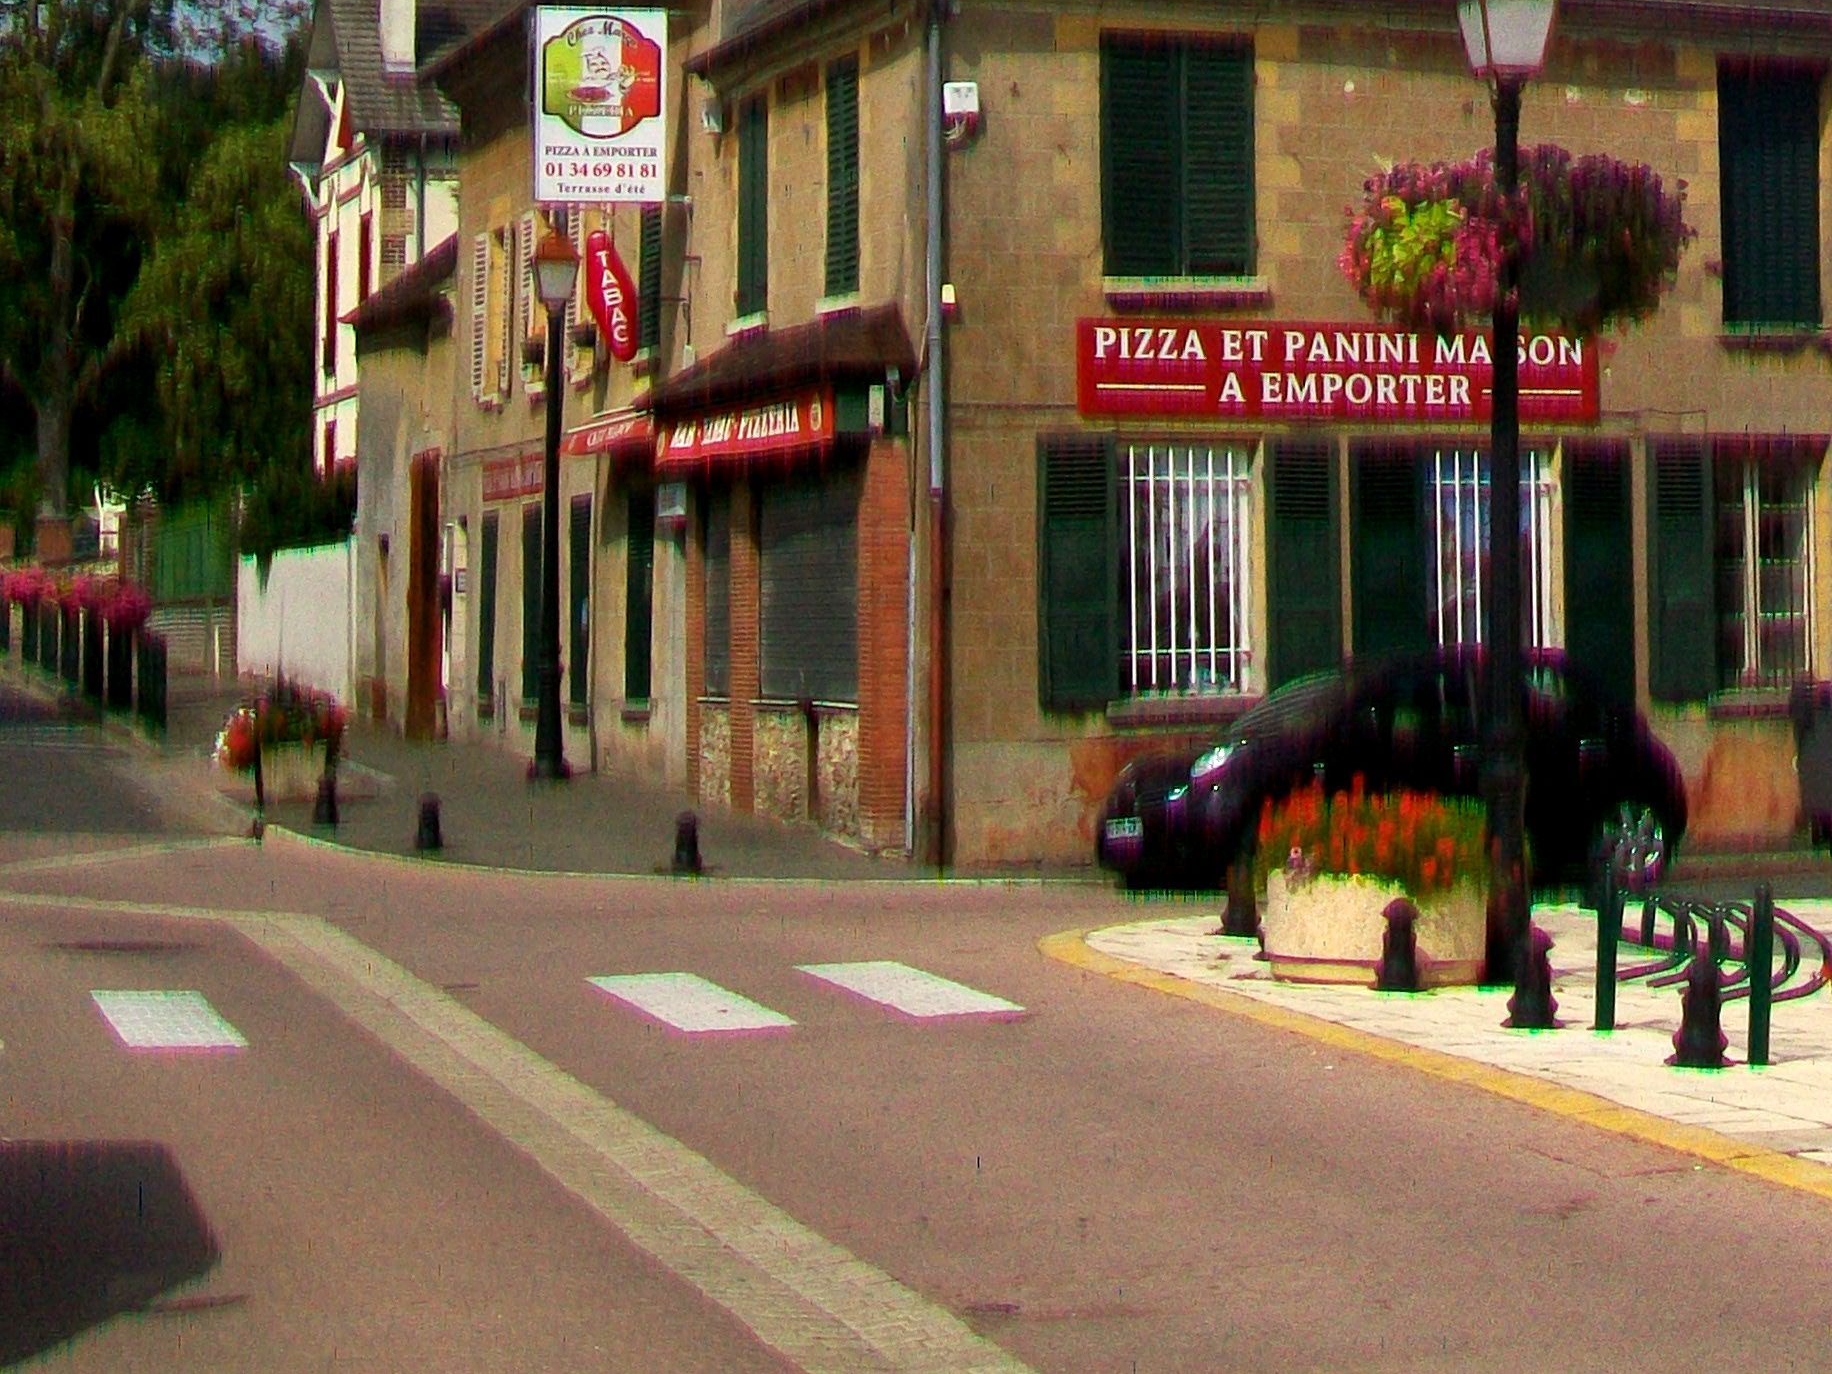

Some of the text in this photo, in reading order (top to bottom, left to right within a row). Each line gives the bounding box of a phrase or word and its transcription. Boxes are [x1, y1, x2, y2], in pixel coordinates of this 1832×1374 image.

[545, 146, 579, 156] PIZZA
[593, 147, 657, 157] EMPORTER
[545, 162, 656, 178] 01 34 69 81 81
[557, 182, 645, 194] Terrasse d'été
[595, 250, 629, 342] TABAC
[1094, 327, 1582, 366] PIZZA ET PANINI MASON
[1218, 372, 1471, 405] A EMPORTER
